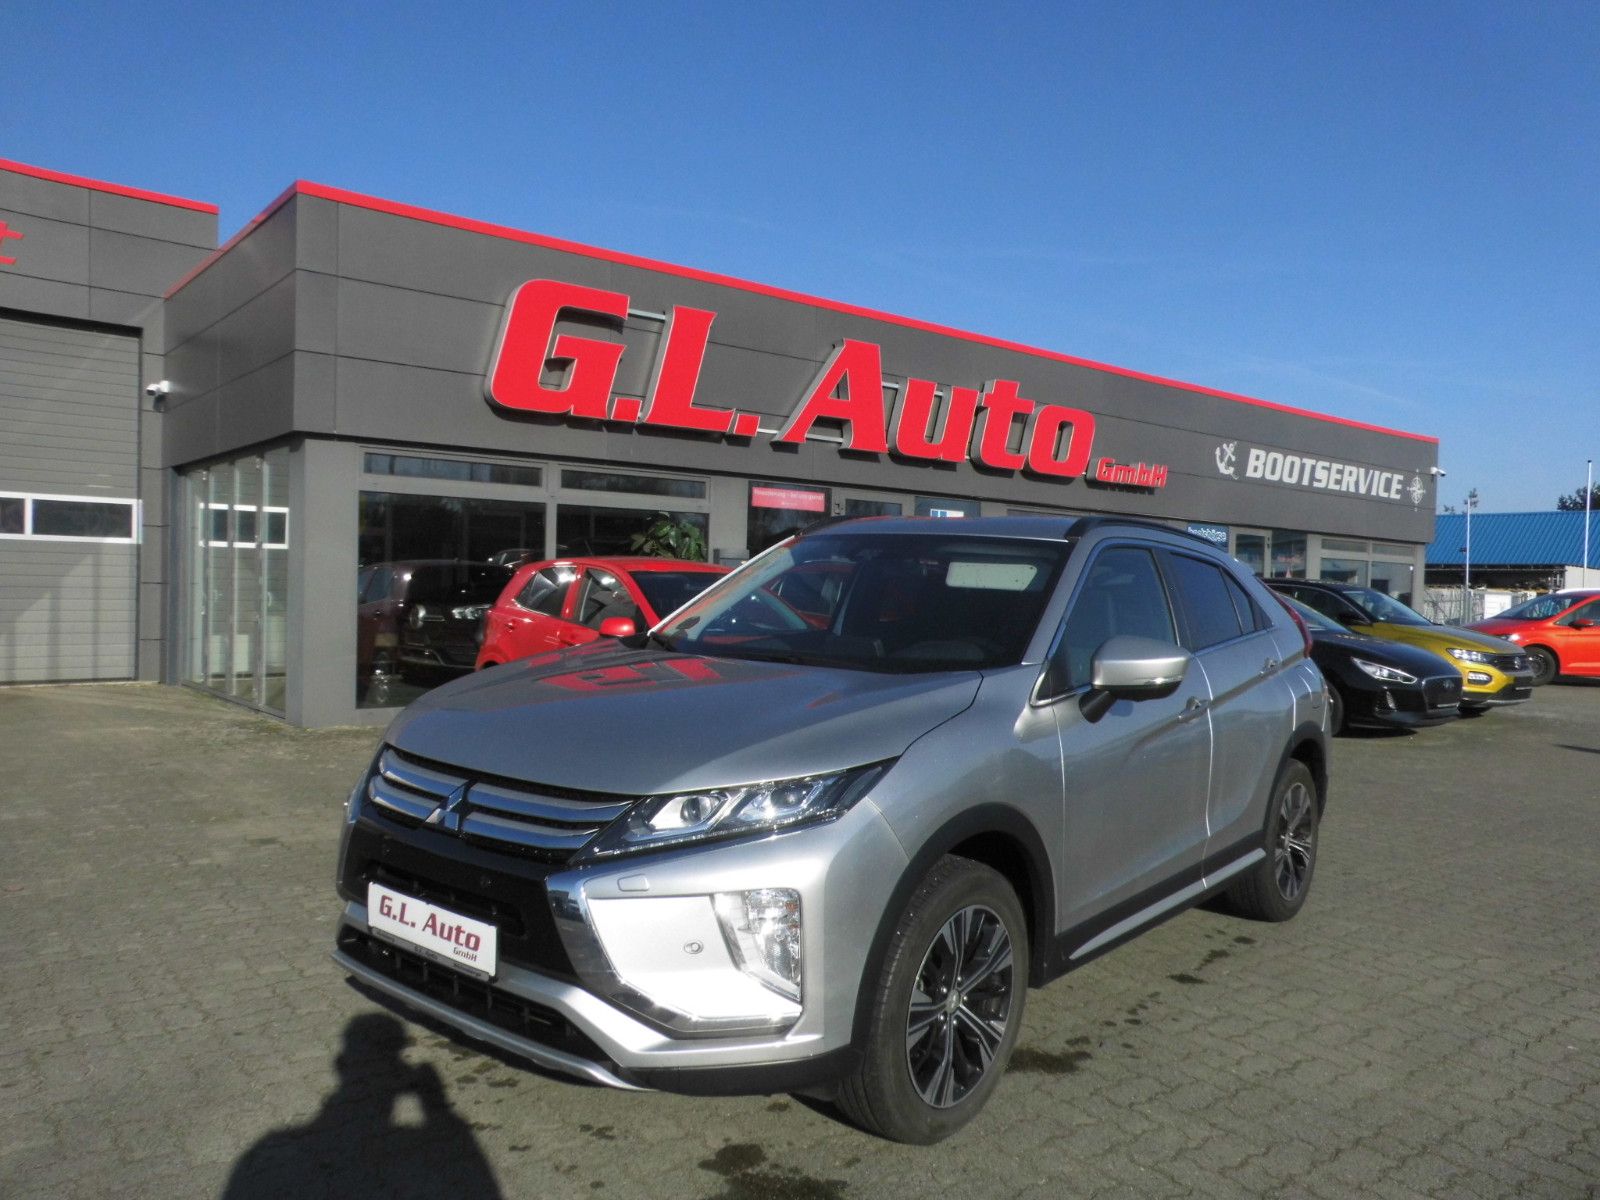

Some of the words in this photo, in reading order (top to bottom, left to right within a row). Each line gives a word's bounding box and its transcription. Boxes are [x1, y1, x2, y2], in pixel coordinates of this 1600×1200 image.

[486, 278, 761, 438] G.L.
[776, 338, 1096, 478] Auto
[1094, 457, 1168, 489] GmbH
[1245, 448, 1404, 500] BOOTSERVICE
[379, 894, 416, 928] G.L.
[422, 912, 481, 952] Auto
[453, 946, 478, 962] GmbH
